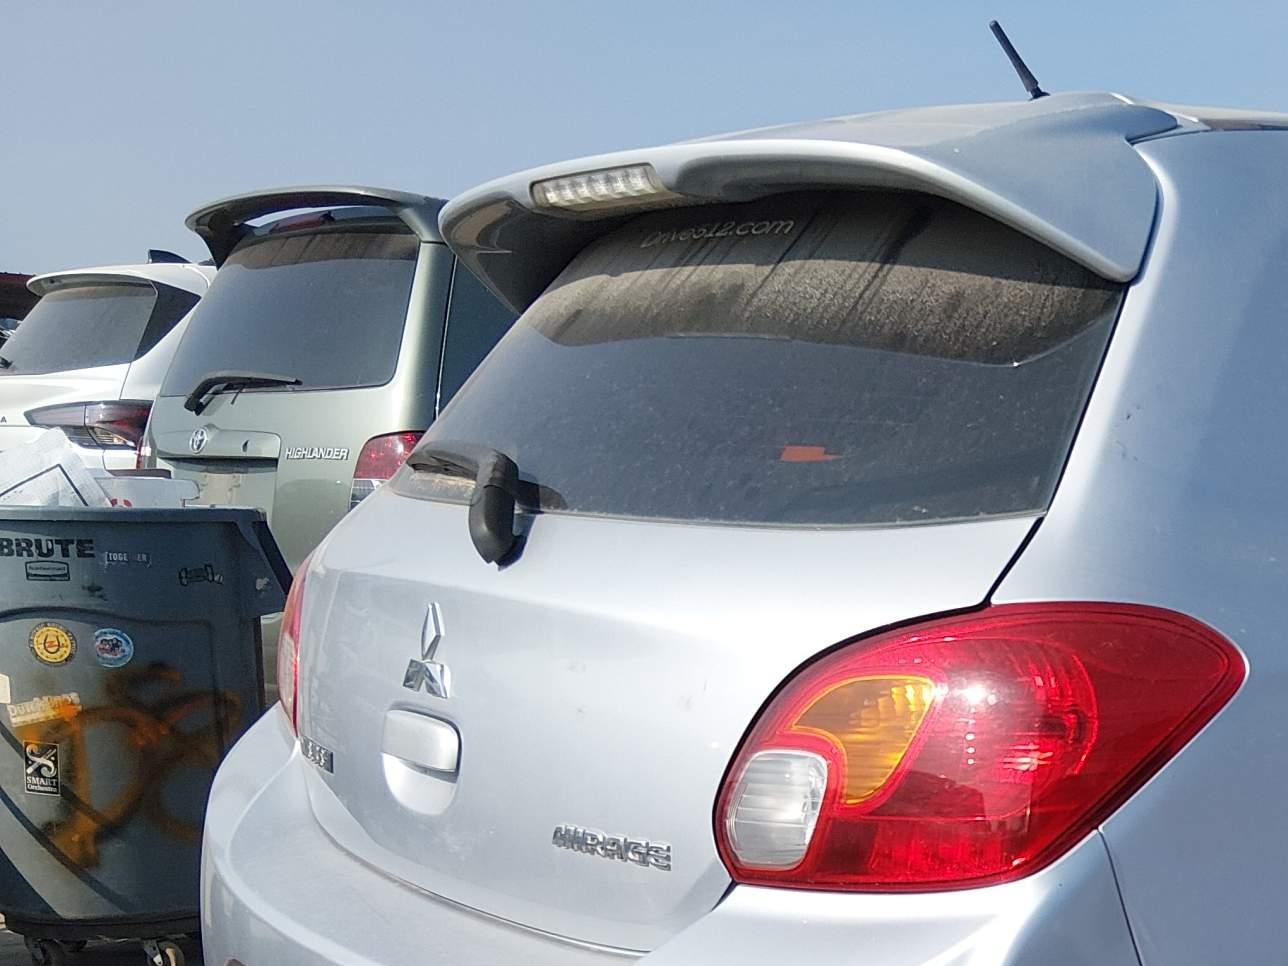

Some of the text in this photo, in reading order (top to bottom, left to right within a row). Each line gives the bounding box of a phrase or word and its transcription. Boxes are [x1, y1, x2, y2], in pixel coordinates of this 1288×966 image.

[285, 447, 350, 461] HIGHLANDER
[0, 538, 96, 558] BRUTE
[552, 825, 672, 872] MIRAGE
